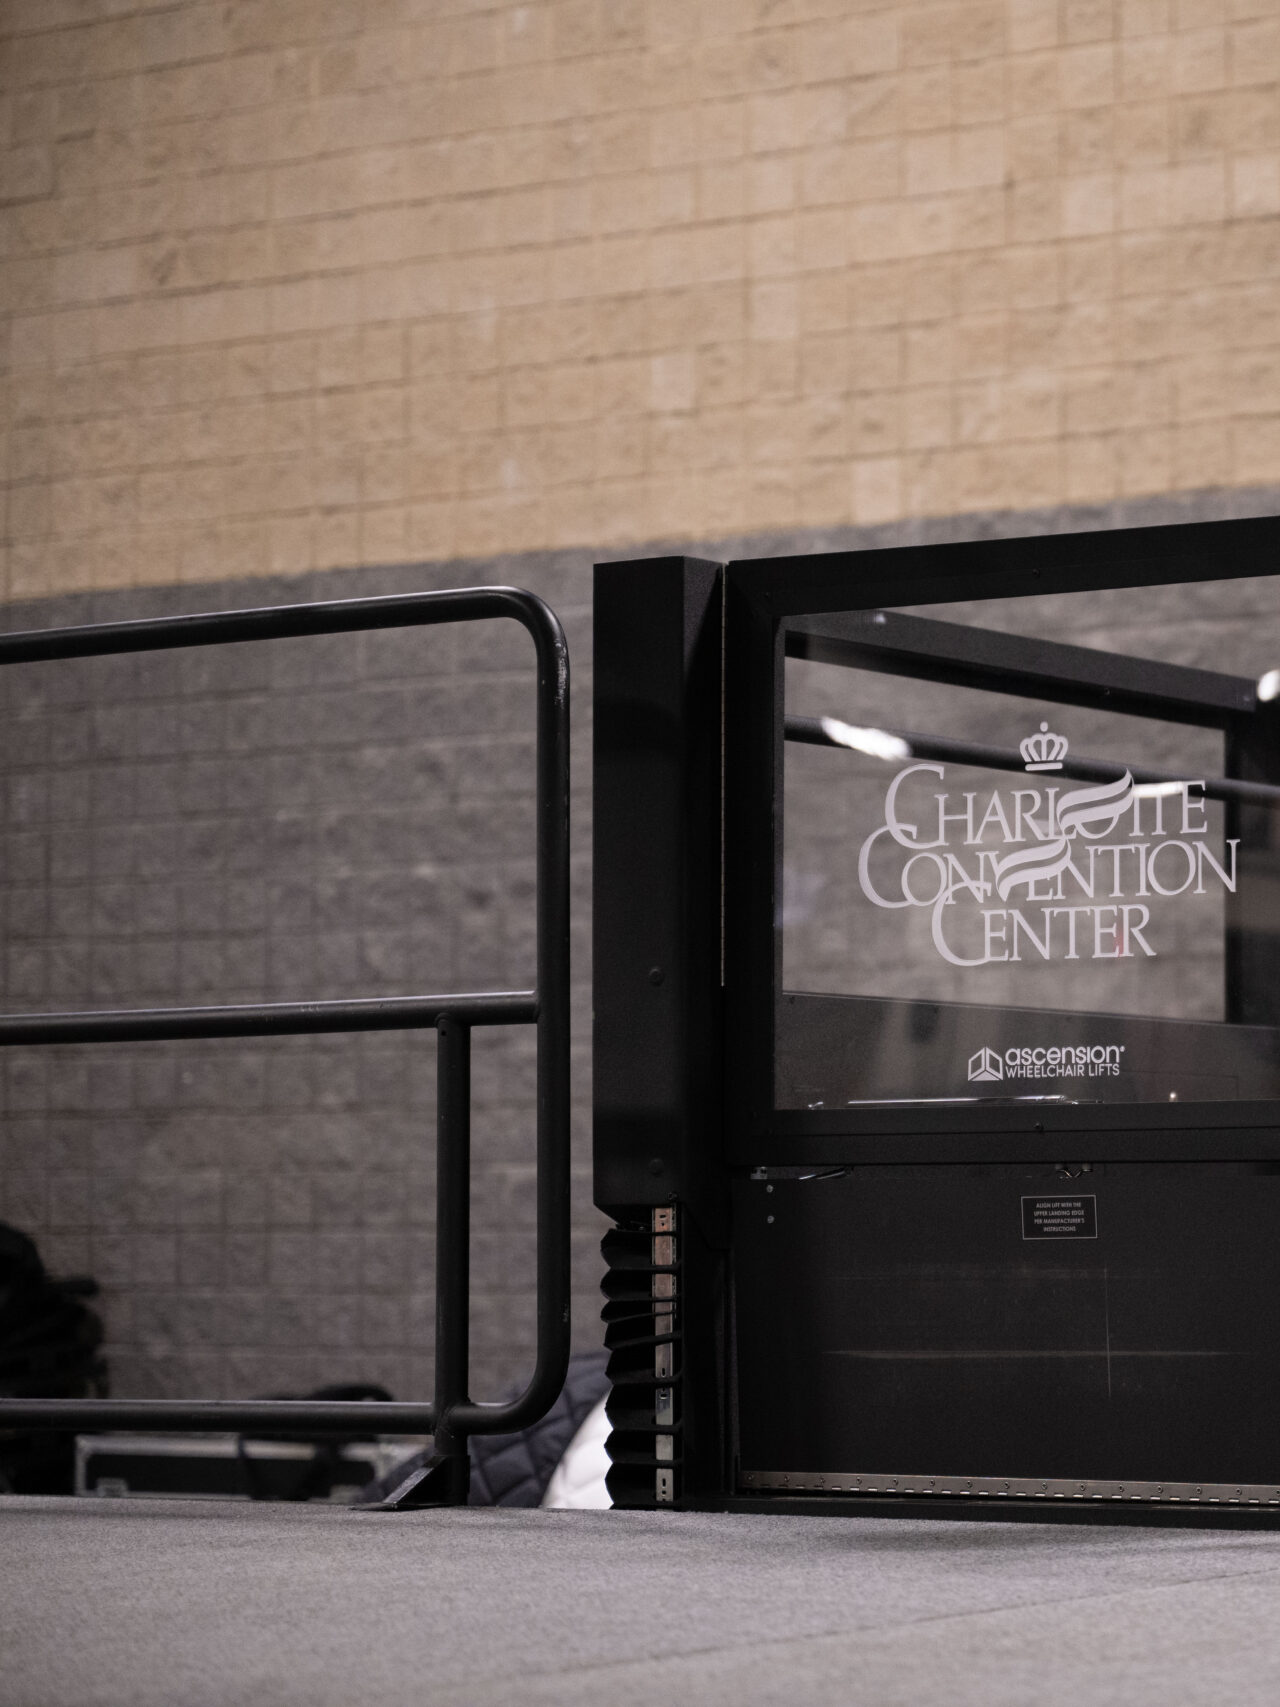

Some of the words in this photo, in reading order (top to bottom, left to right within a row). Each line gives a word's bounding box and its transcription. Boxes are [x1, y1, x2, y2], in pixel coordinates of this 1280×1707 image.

[931, 880, 1157, 967] CENTER
[1005, 1064, 1085, 1079] WHEELCHAIR
[1088, 1063, 1120, 1077] LIFTS
